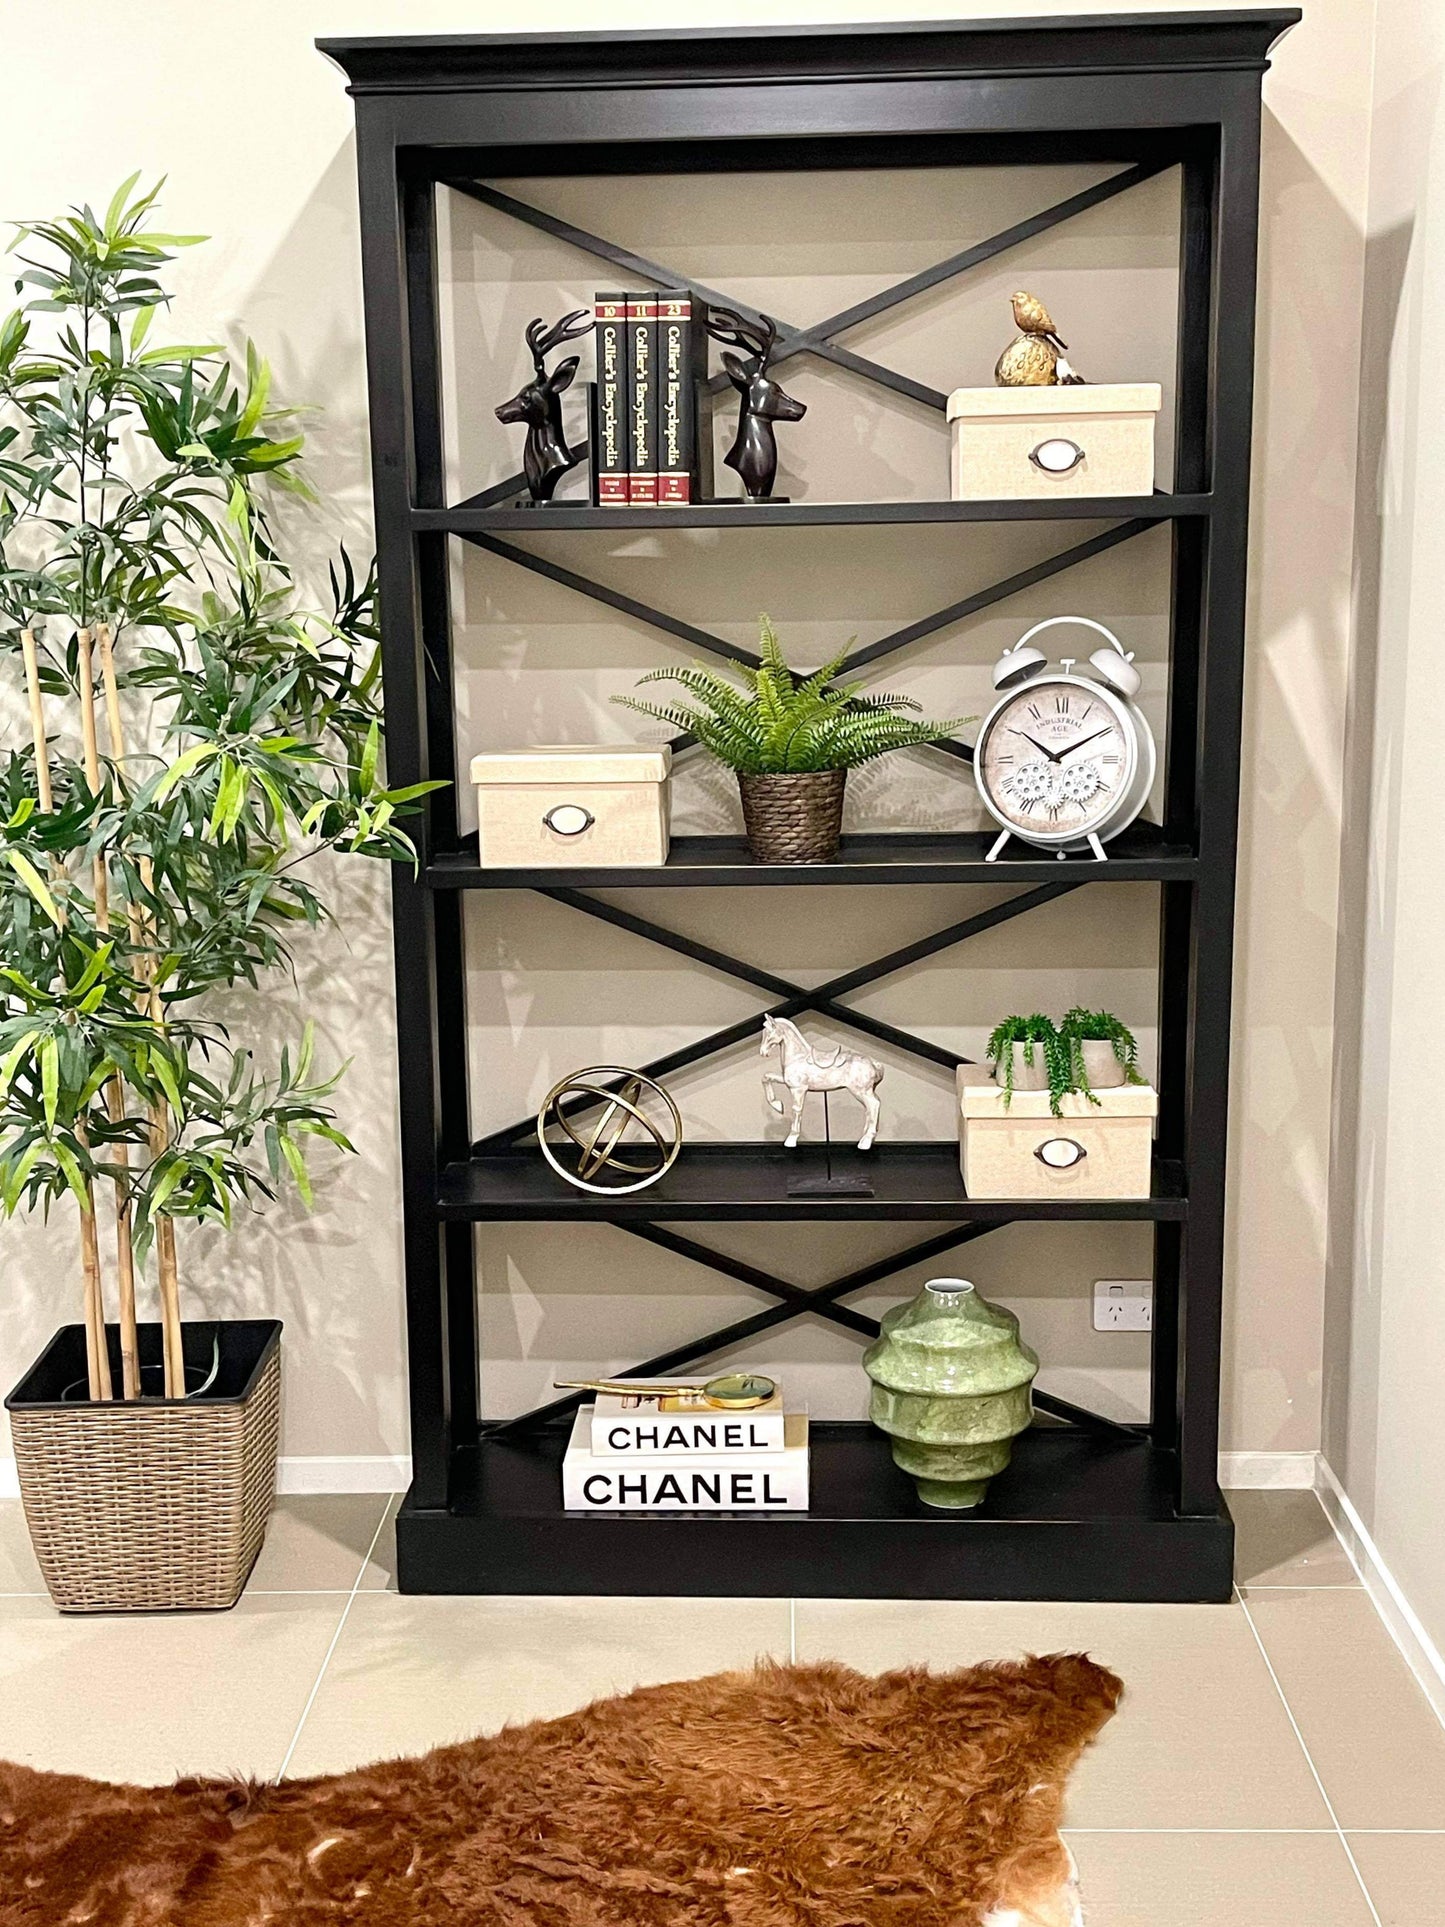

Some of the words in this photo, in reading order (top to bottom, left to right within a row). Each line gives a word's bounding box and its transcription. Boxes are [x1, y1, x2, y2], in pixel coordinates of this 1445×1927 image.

[603, 306, 616, 317] 10
[635, 306, 647, 317] 11
[667, 304, 681, 316] 23
[604, 326, 616, 381] Collier's
[635, 326, 648, 381] Collier's
[668, 325, 681, 381] Collier's
[601, 382, 618, 467] Encyclopedia
[632, 382, 648, 467] Encyclopedia
[664, 381, 681, 467] Encyclopedia
[1036, 716, 1083, 730] INDUSTRIAL
[608, 1424, 769, 1450] CHANEL
[583, 1474, 788, 1505] CHANEL
